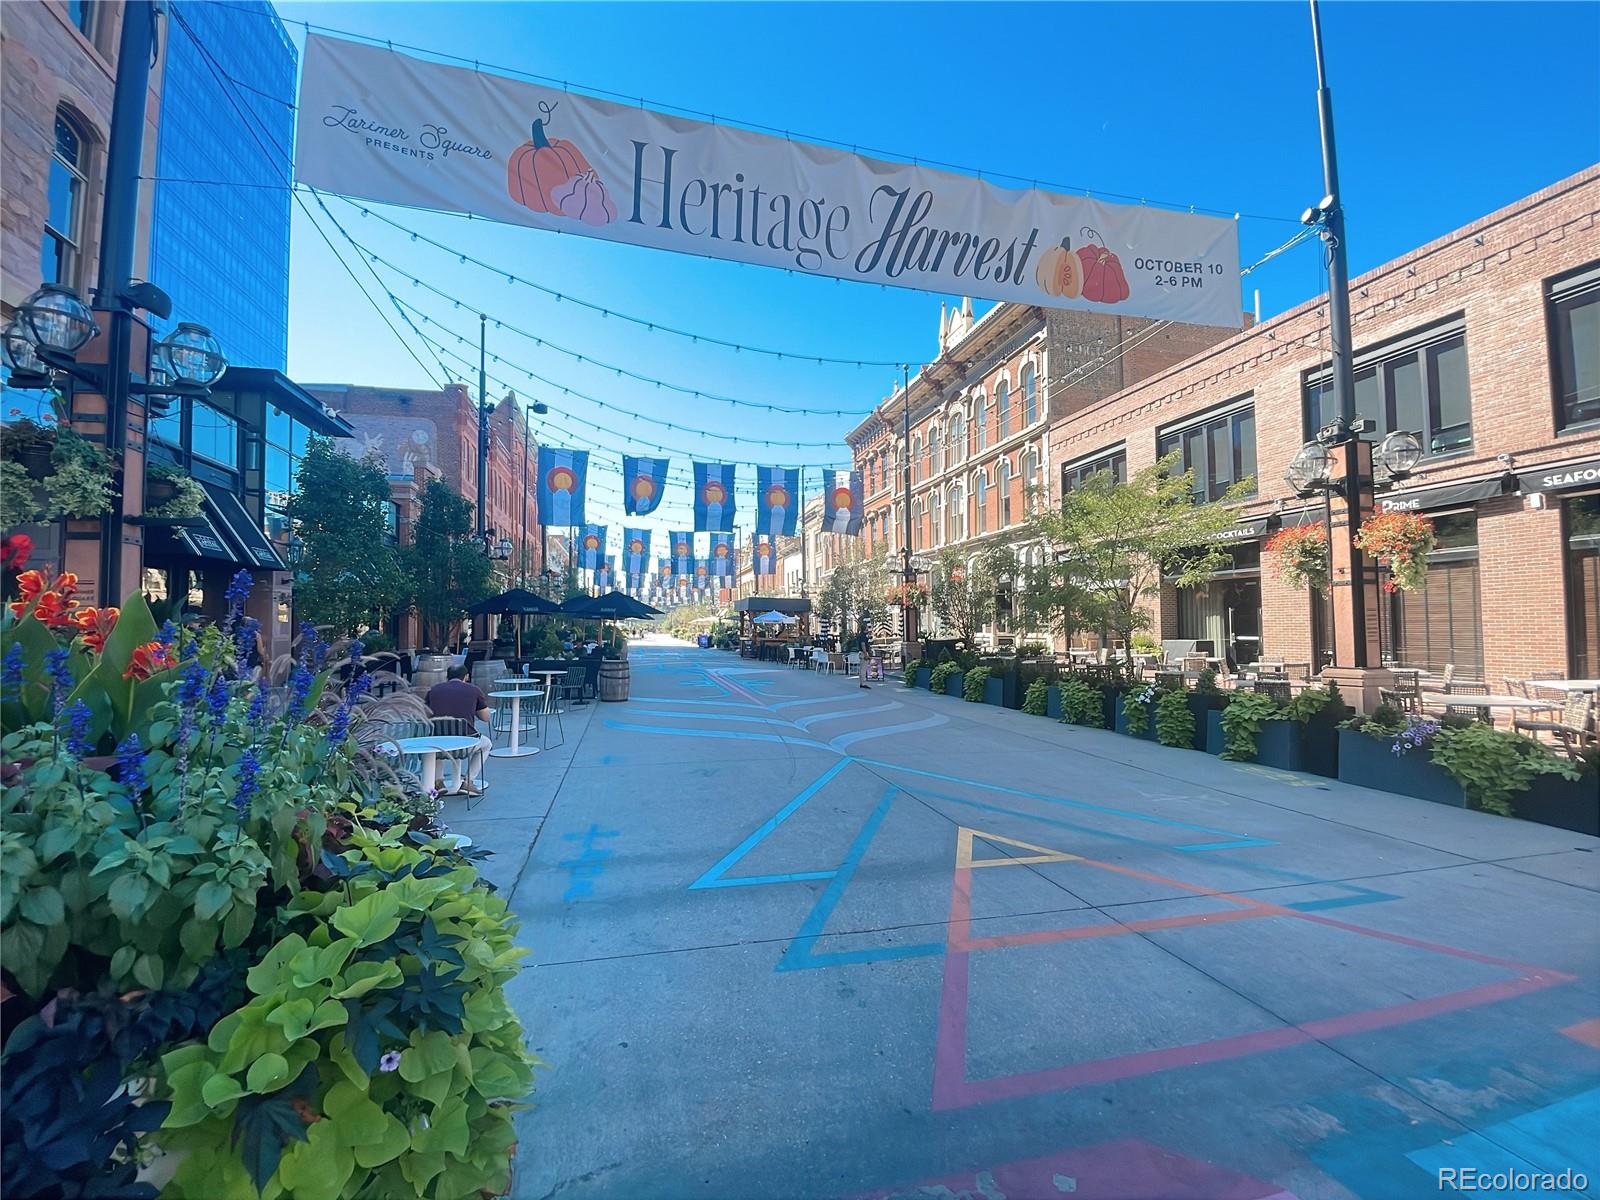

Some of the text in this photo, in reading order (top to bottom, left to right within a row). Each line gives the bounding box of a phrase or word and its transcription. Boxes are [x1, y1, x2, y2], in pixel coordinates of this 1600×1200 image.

[322, 105, 493, 160] Larimer Square
[365, 137, 435, 161] PRESENTS
[627, 138, 1040, 286] Heritage Harvest
[1134, 257, 1224, 275] OCTOBER 10
[1154, 274, 1203, 289] 2-6 PM
[1543, 468, 1600, 487] SEAFO
[1382, 498, 1421, 513] PRIME
